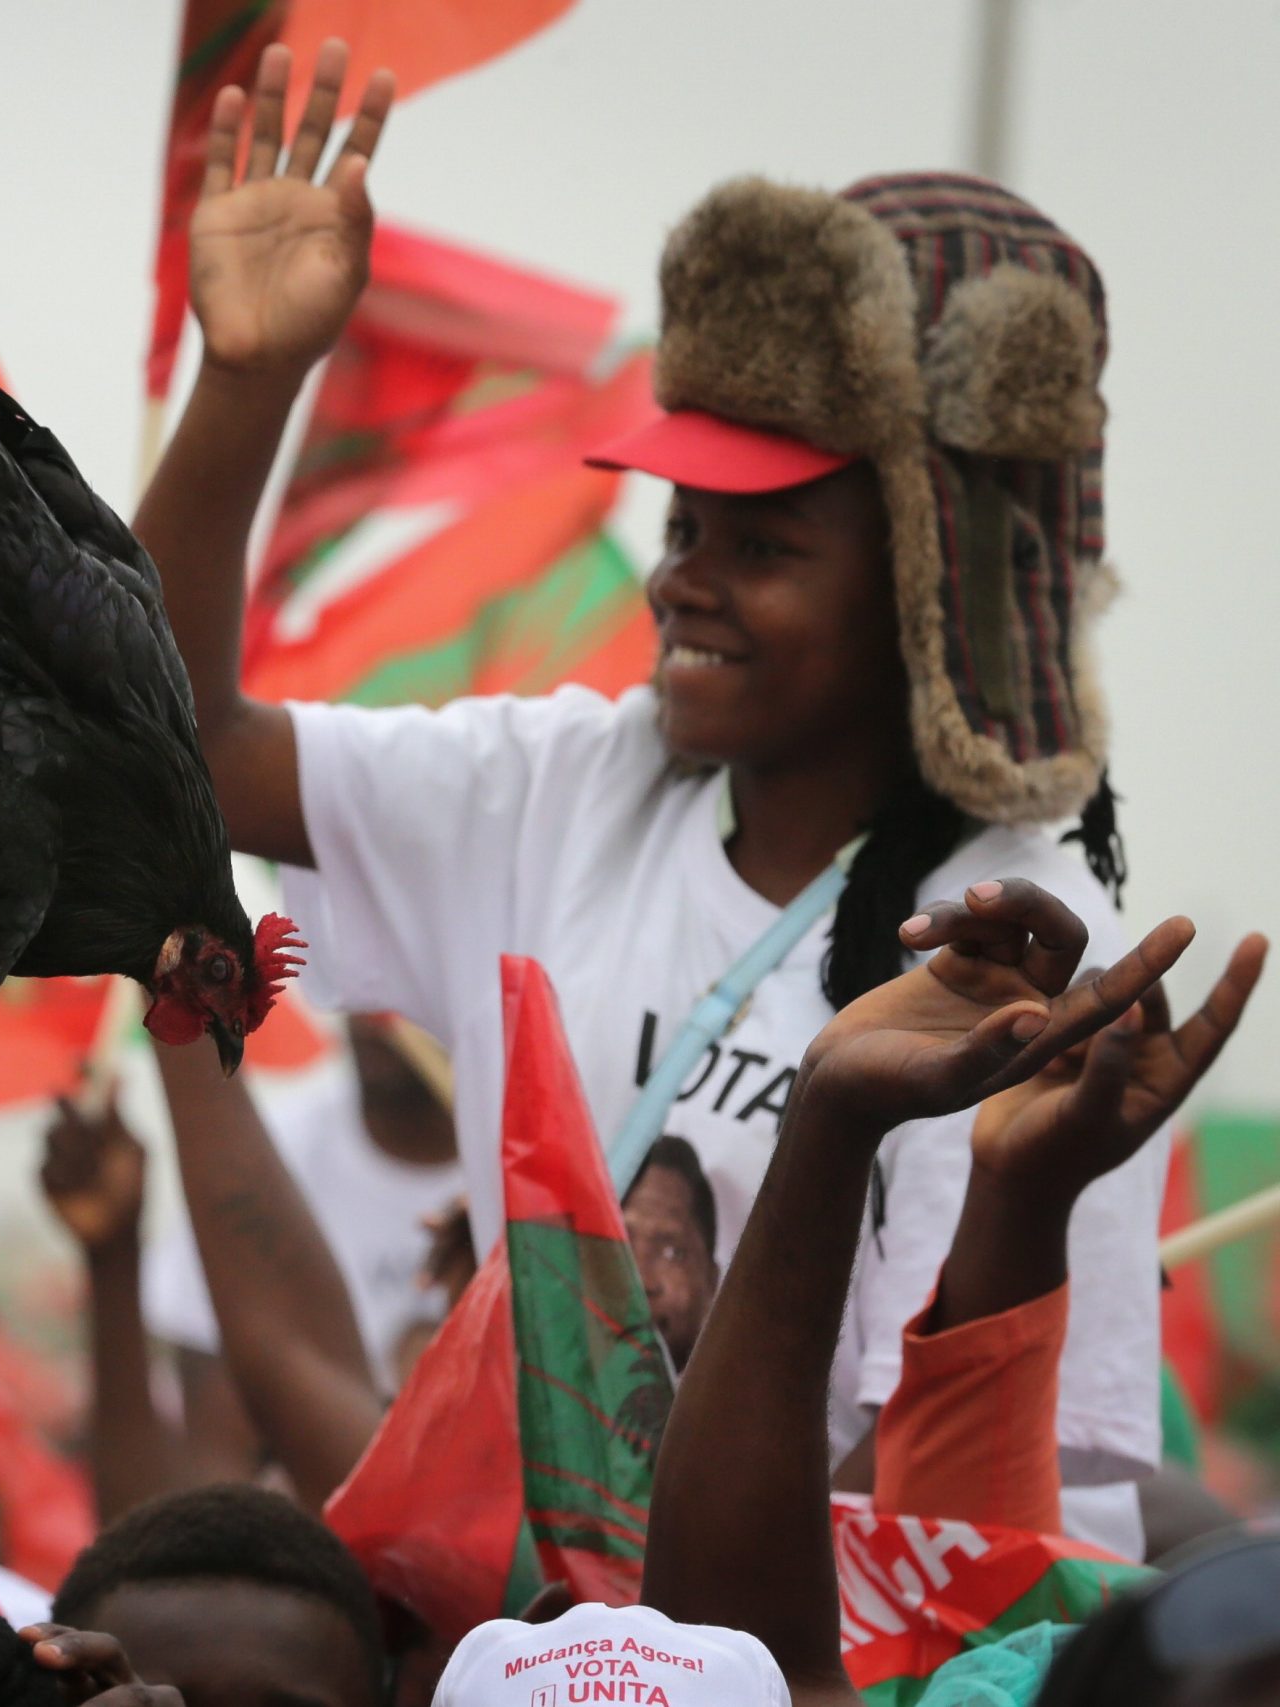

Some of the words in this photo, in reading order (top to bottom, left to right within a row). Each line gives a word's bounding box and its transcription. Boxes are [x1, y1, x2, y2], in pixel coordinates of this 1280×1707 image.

[505, 1639, 613, 1679] Mudança
[621, 1637, 704, 1673] Agora!
[565, 1660, 639, 1679] VOTA
[539, 1692, 546, 1707] 1
[568, 1680, 670, 1707] UNITA
